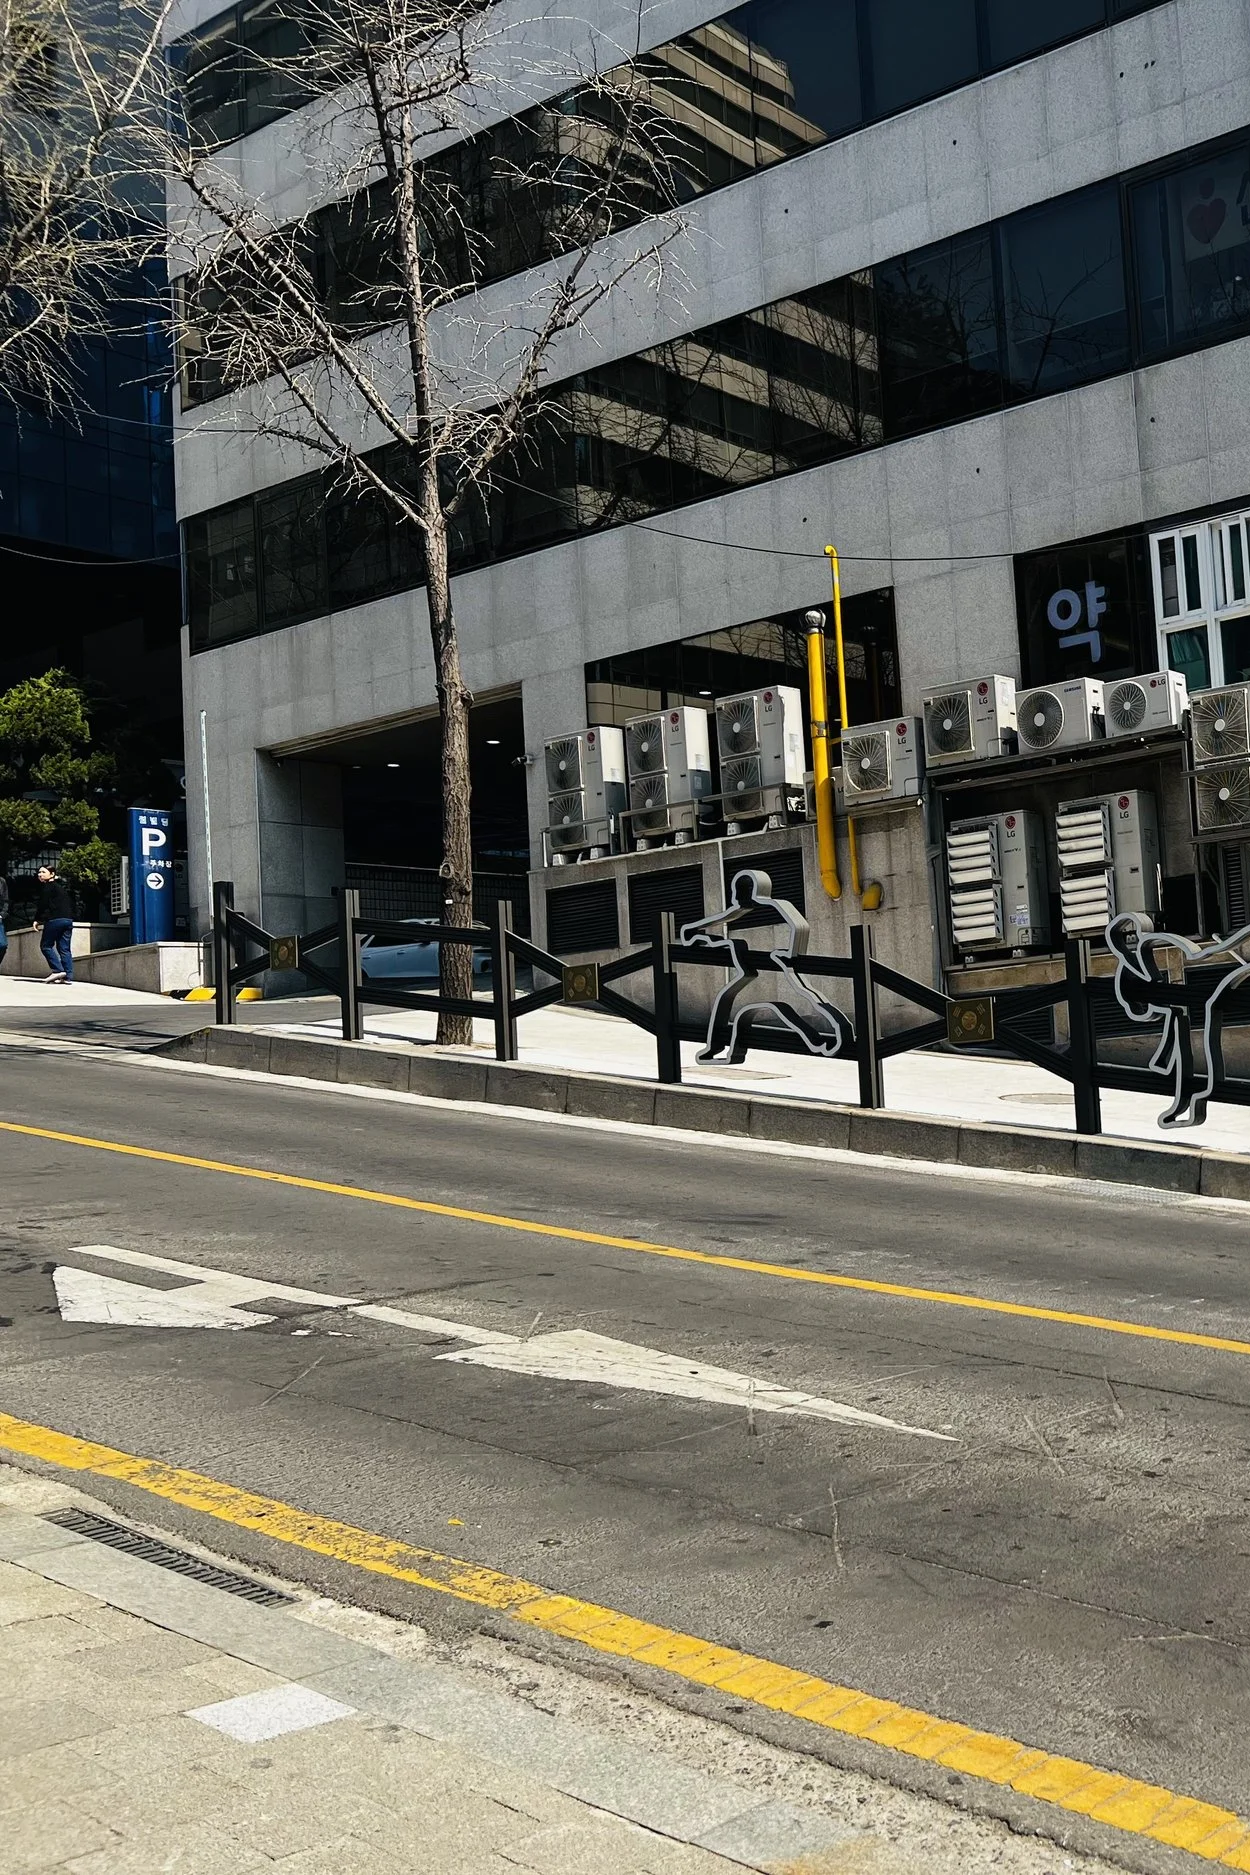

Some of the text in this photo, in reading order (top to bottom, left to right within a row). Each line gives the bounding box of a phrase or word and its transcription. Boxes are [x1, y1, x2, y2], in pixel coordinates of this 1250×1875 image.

[1048, 579, 1108, 664] 약
[979, 697, 989, 705] LG
[764, 705, 773, 713] LG
[671, 725, 680, 733] LG
[896, 737, 907, 745] LG
[588, 744, 597, 752] LG
[1119, 811, 1130, 820] LG
[1006, 830, 1017, 838] LG
[141, 827, 167, 856] P
